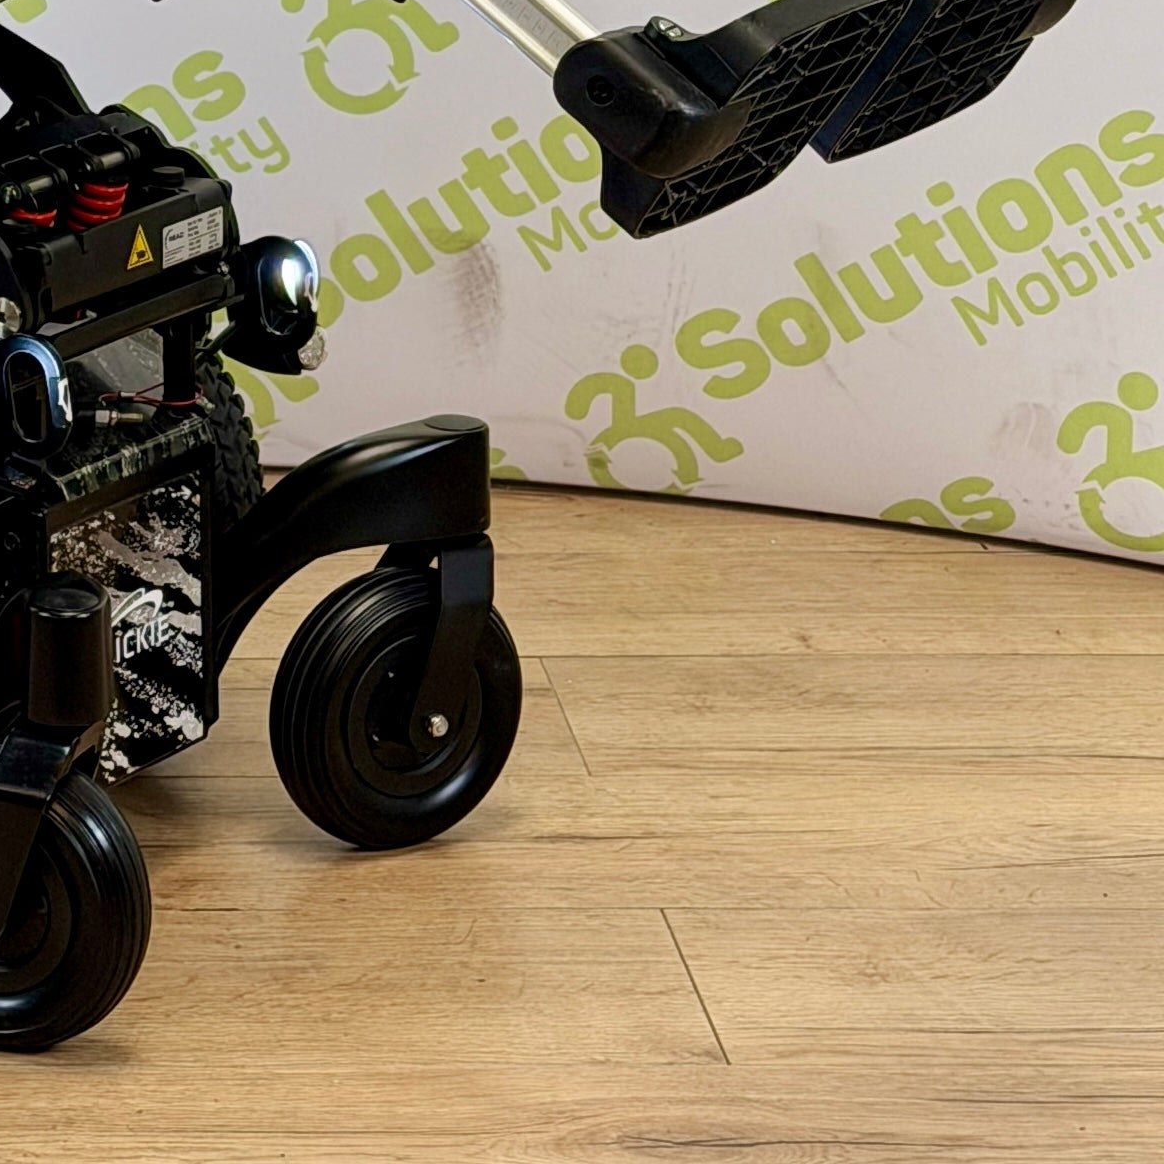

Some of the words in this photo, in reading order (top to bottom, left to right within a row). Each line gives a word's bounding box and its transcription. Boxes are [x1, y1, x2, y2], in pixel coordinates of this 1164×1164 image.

[314, 112, 603, 331] olutio
[672, 109, 1164, 402] Solutions
[950, 201, 1164, 348] Mobilit
[115, 614, 176, 664] ICKIE
